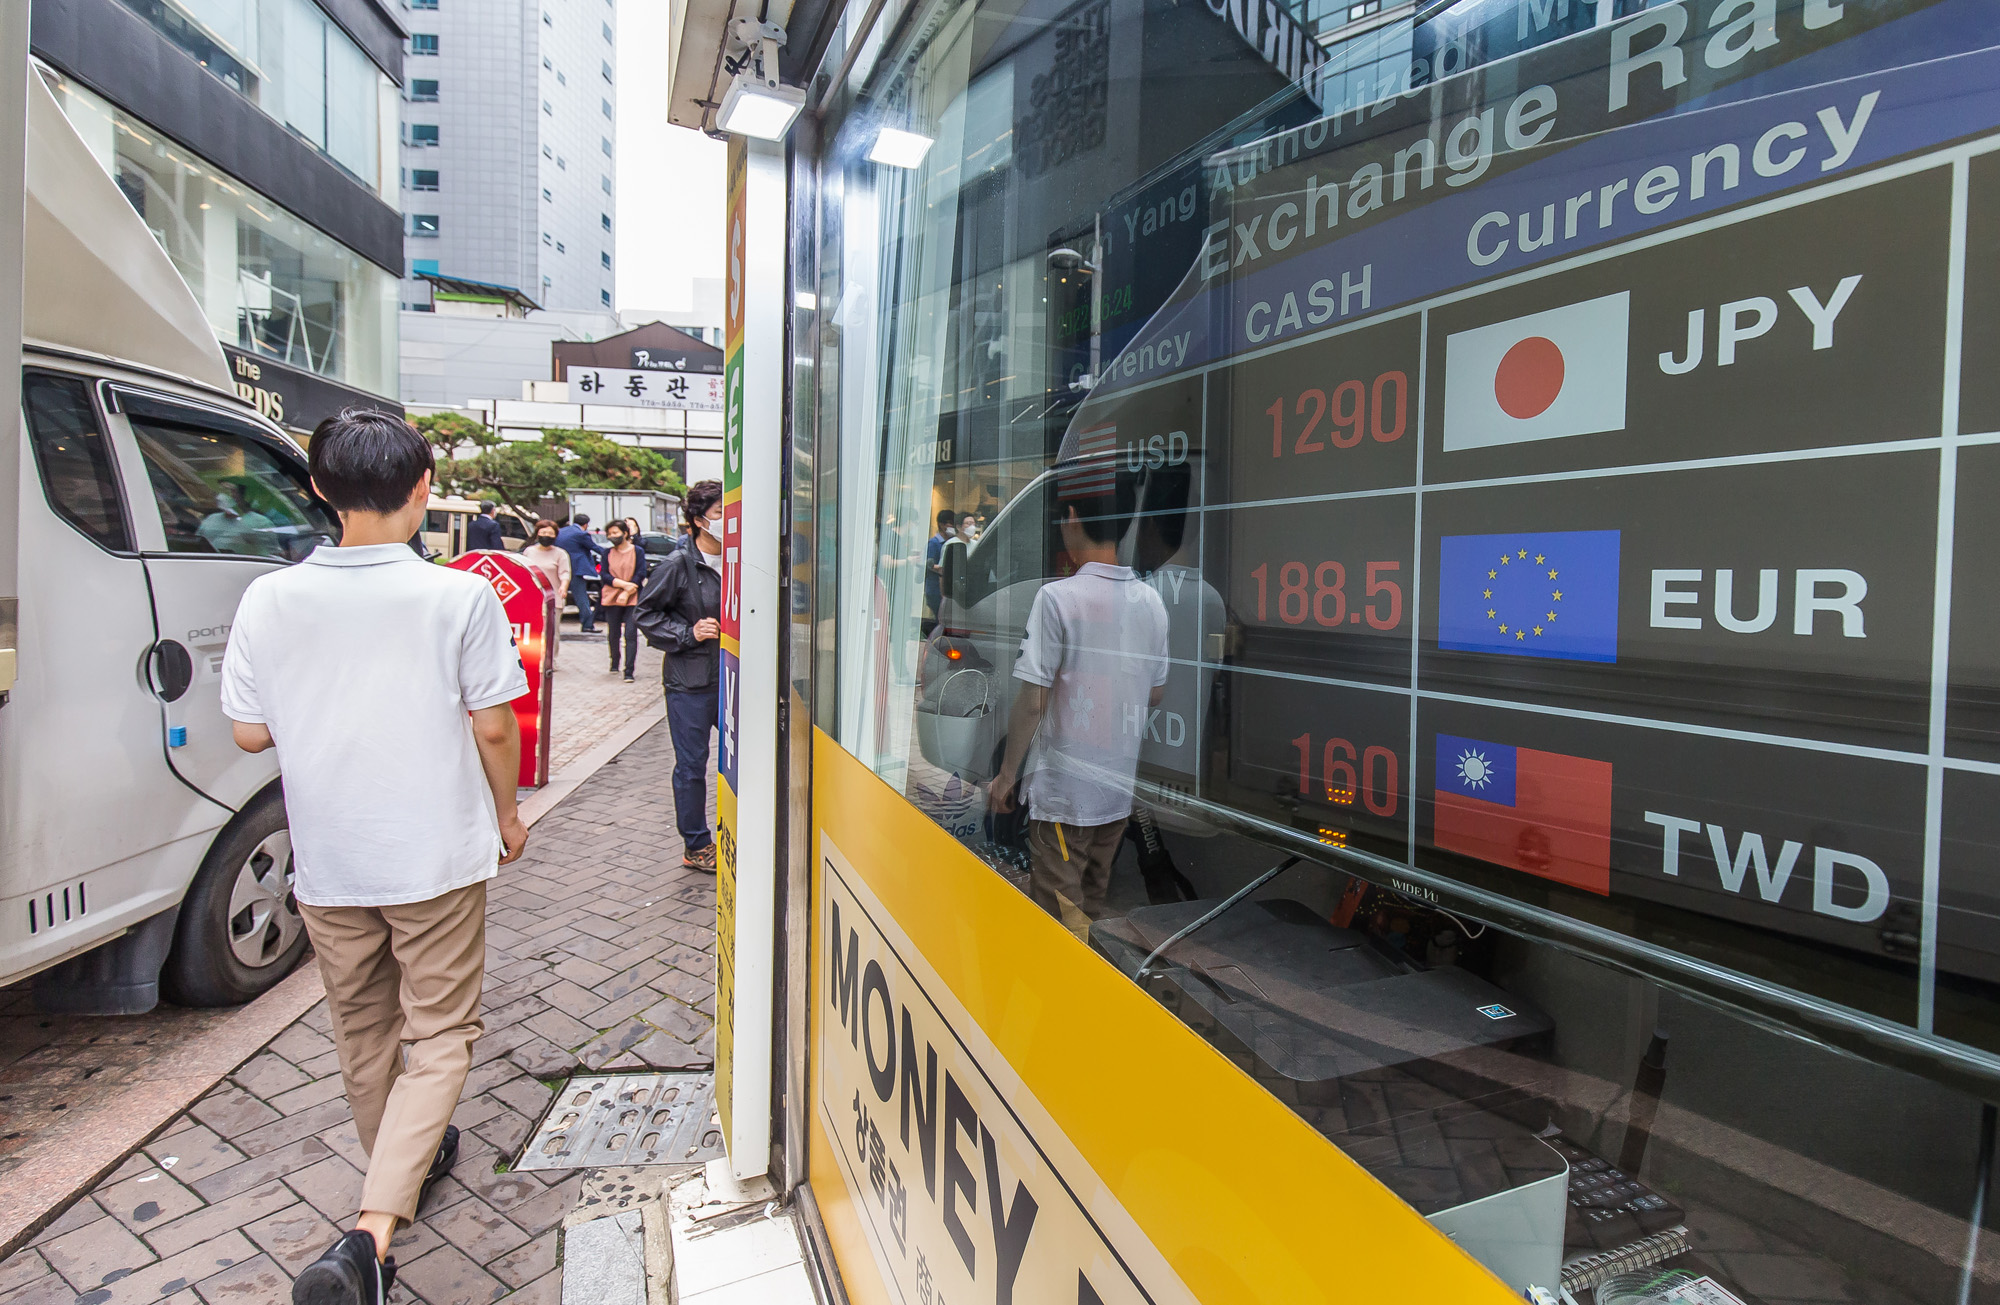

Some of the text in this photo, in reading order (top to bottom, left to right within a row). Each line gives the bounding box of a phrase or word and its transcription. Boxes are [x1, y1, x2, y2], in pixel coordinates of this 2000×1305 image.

[1123, 184, 1197, 244] Yang
[1209, 18, 1467, 200] Authorized
[1200, 85, 1558, 282] Exchange
[1245, 263, 1372, 343] CASH
[1466, 90, 1881, 267] Currency
[236, 355, 261, 380] the
[1127, 274, 1863, 474] USD 1290 JPY
[1250, 561, 1403, 631] 188.5
[1650, 568, 1868, 638] EUR
[1122, 701, 1890, 922] HKD 160 TWD
[832, 897, 1039, 1305] MONEY
[853, 1087, 907, 1261] 상품권
